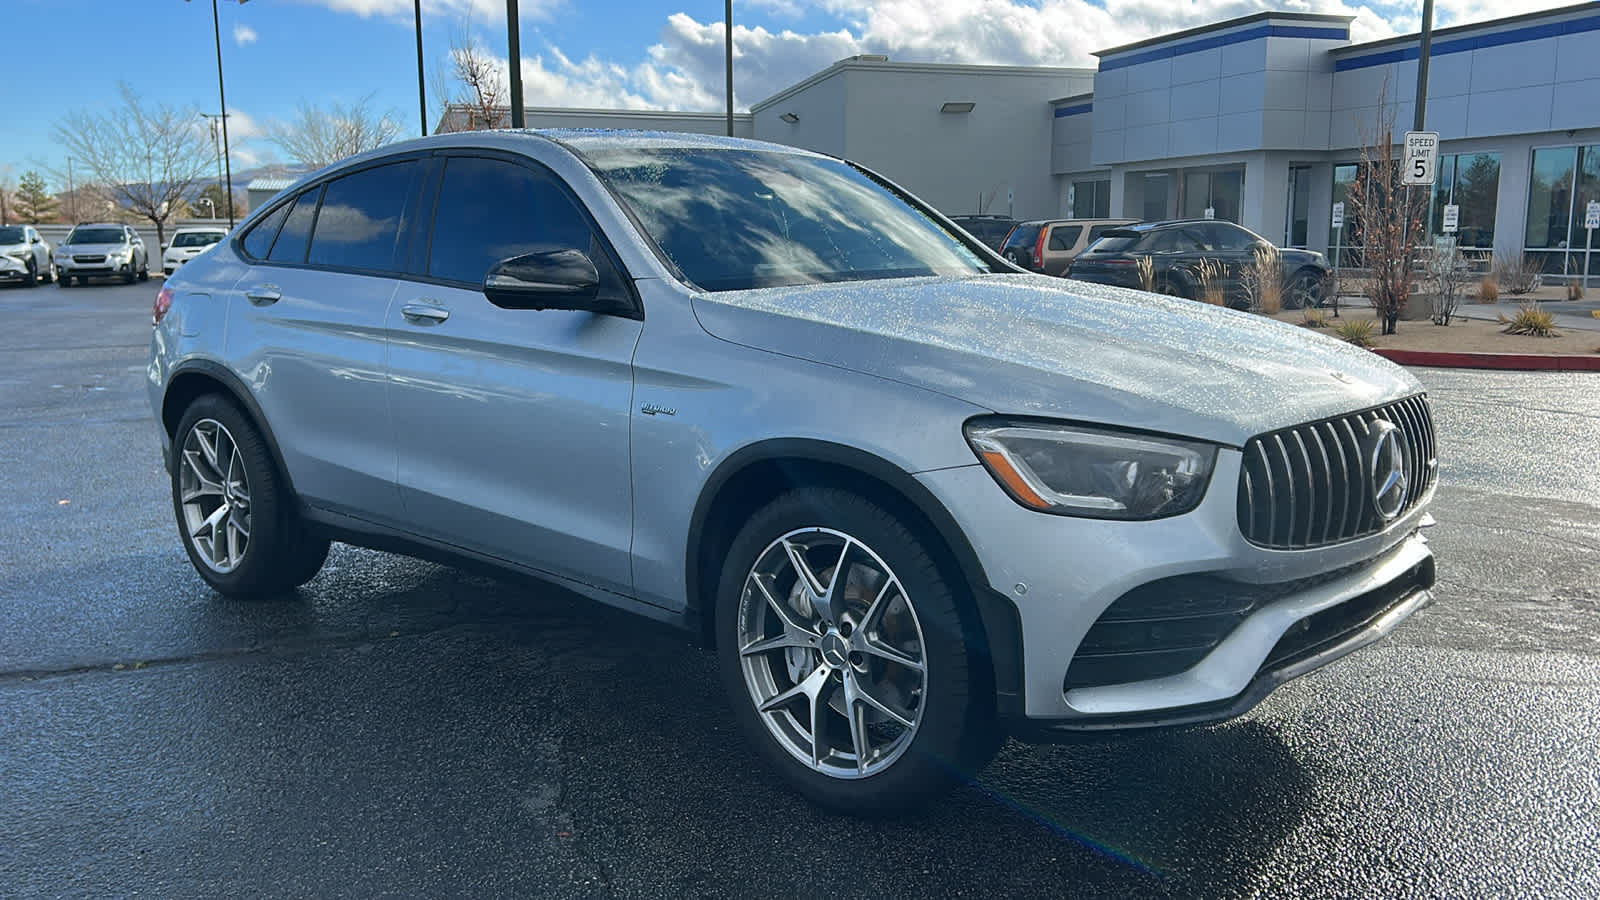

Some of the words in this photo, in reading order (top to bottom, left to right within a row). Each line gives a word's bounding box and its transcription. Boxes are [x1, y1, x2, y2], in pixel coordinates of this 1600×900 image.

[1409, 138, 1434, 147] SPEED
[1411, 149, 1431, 158] LIMIT
[1414, 160, 1425, 177] 5
